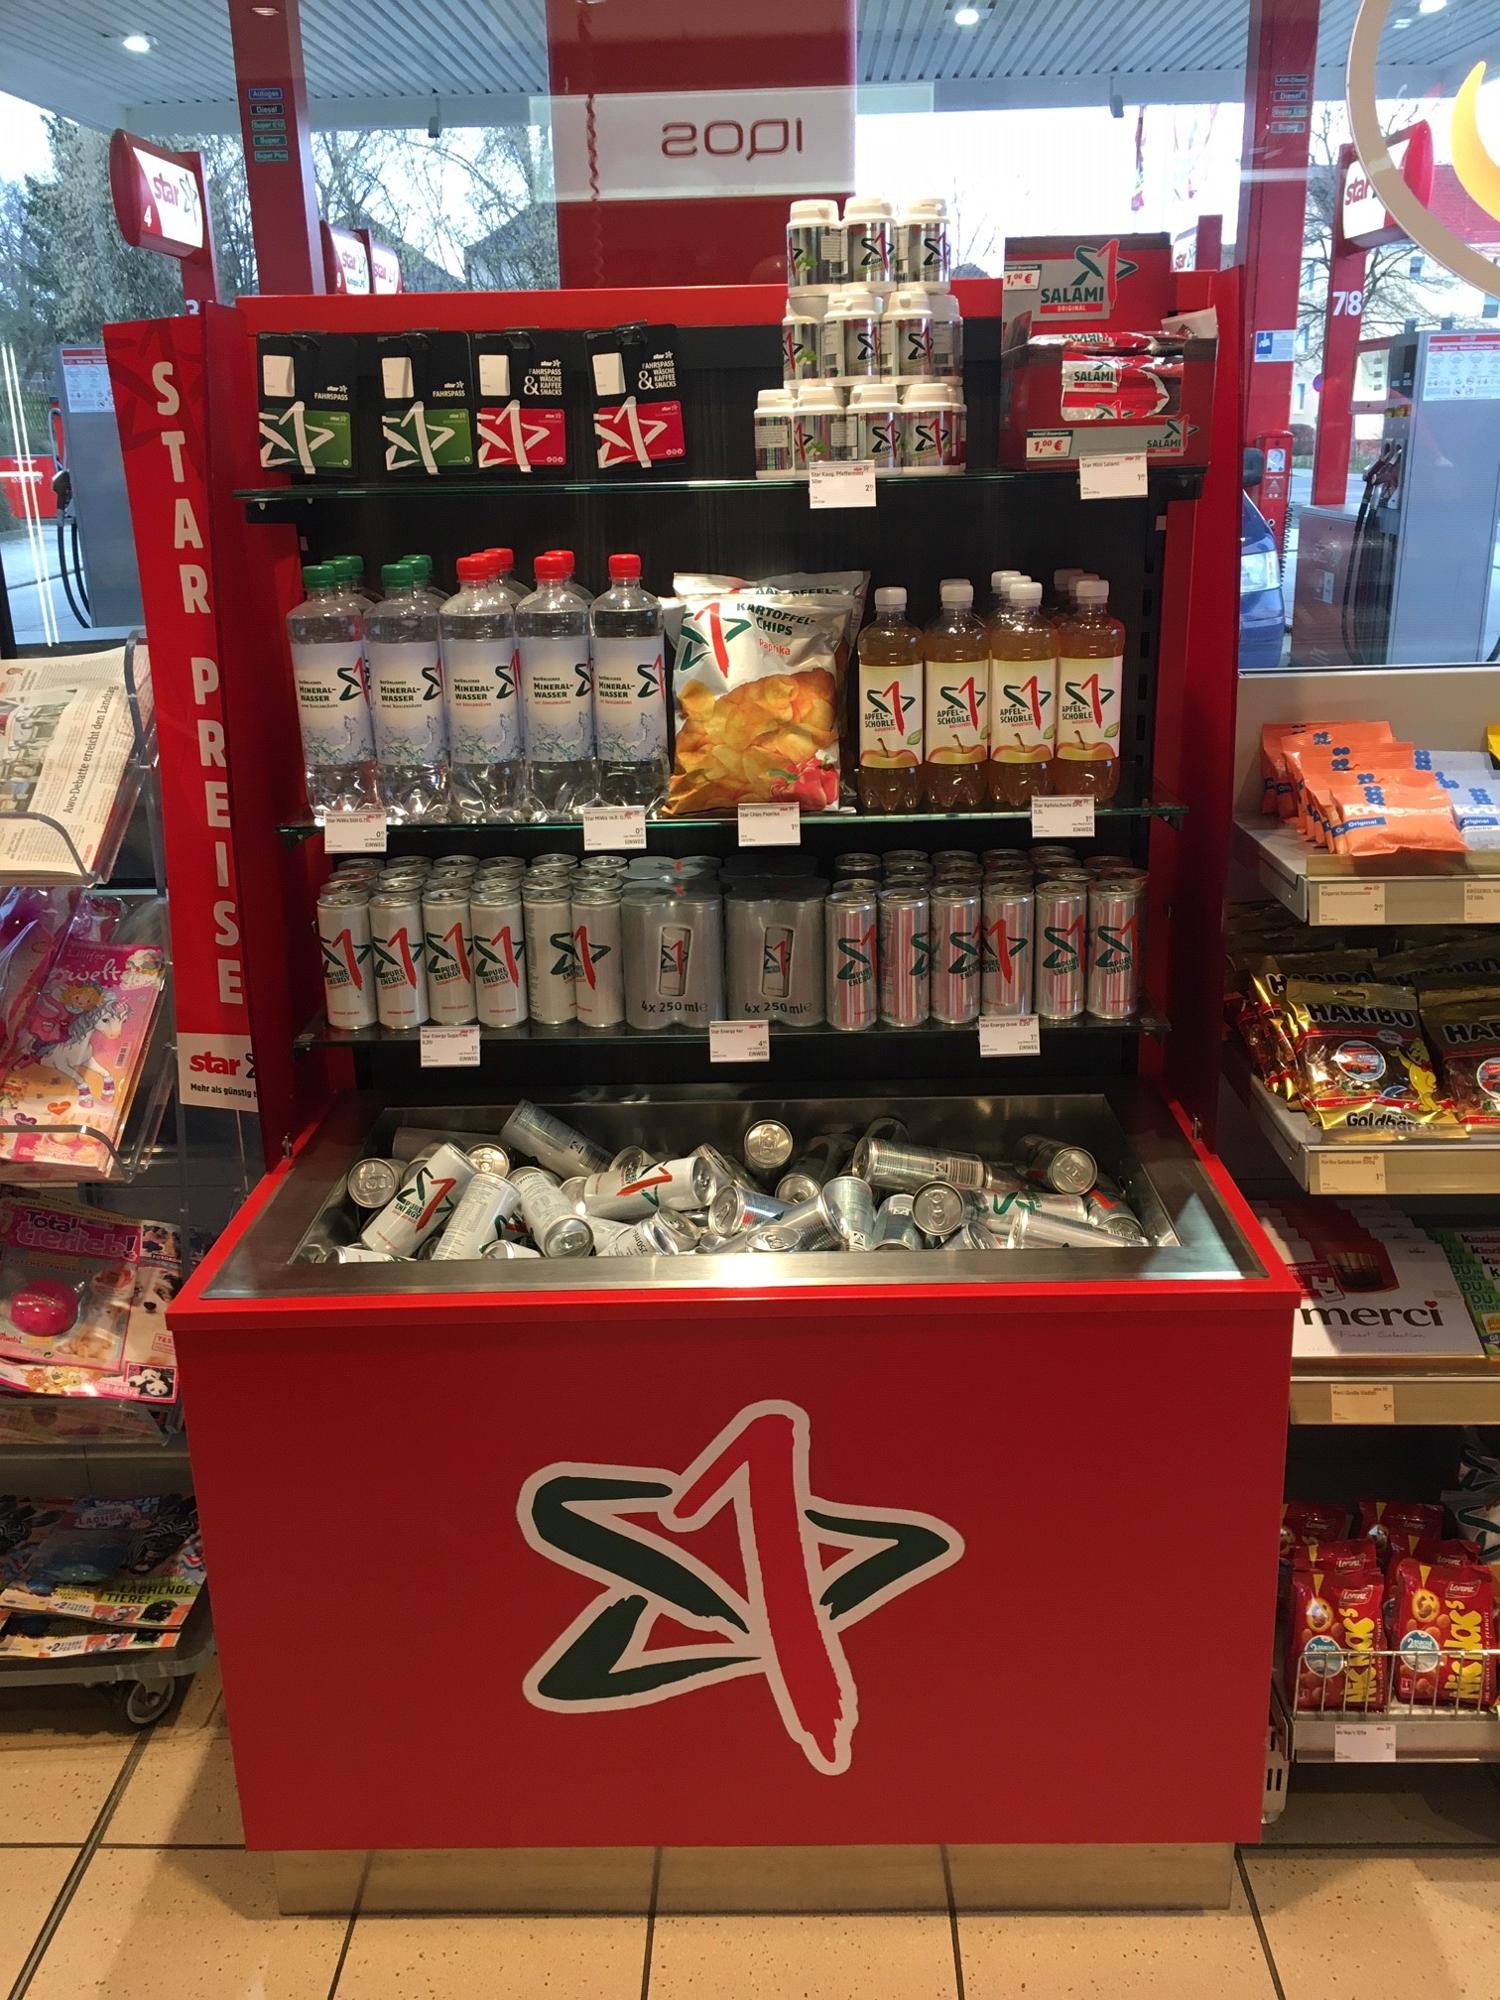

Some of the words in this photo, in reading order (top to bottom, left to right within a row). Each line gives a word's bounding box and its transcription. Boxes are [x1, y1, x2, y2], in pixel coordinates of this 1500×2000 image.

[153, 171, 179, 207] star
[144, 204, 152, 228] 4
[1040, 286, 1105, 304] SALAMI
[1057, 304, 1086, 312] ORIGINAL
[642, 360, 675, 370] FAHRSPASS
[528, 368, 562, 376] FAHRSPASS
[1073, 371, 1114, 382] SALAMI
[637, 370, 656, 390] &
[654, 374, 676, 382] KAFFEE
[523, 375, 539, 396] &
[539, 381, 563, 389] KAFFEE
[314, 392, 348, 401] FAHRSPASS
[432, 389, 466, 398] FAHRSPASS
[1054, 440, 1064, 452] €
[1146, 439, 1182, 449] SALAMI
[151, 360, 212, 615] STAR
[736, 602, 817, 625] KARTOFFEL-
[755, 617, 793, 636] CHIPS
[759, 638, 791, 656] Paprika
[380, 686, 421, 694] MINERAL-
[454, 684, 495, 692] MINERAL-
[533, 683, 574, 691] MINERAL-
[97, 685, 120, 714] Landtag
[381, 694, 415, 702] WASSER
[937, 709, 964, 718] APFEL-
[1000, 708, 1027, 717] APFEL-
[1062, 705, 1087, 713] APFEL-
[864, 712, 889, 721] APFEL-
[937, 715, 971, 725] SCHORLE
[1000, 714, 1034, 723] SCHORLE
[1062, 711, 1093, 720] SCHORLE
[91, 713, 106, 731] den
[864, 719, 896, 728] SCHORLE
[83, 730, 101, 763] erreicht
[62, 762, 89, 814] Awo-Debatte
[1349, 818, 1376, 828] Original
[189, 656, 244, 1005] PREISE
[330, 970, 348, 978] PURE
[384, 968, 404, 977] PURE
[439, 965, 460, 974] PURE
[487, 967, 507, 978] PURE
[327, 975, 351, 985] ENERGY
[380, 974, 406, 985] ENERGY
[435, 970, 461, 982] ENERGY
[482, 974, 509, 985] ENERGY
[641, 1000, 656, 1013] 4x
[659, 1000, 683, 1013] 250
[744, 1001, 760, 1014] 4x
[763, 1001, 788, 1013] 250
[1306, 1000, 1417, 1029] HARIBO
[189, 1050, 241, 1076] star
[190, 1083, 210, 1092] Mehr
[211, 1085, 223, 1094] als
[223, 1087, 252, 1098] günstig
[404, 1200, 425, 1213] PURE
[1300, 1300, 1444, 1327] merci
[1338, 1558, 1362, 1568] Lorenz
[1449, 1583, 1476, 1594] Lorenz
[105, 1592, 152, 1605] TIERE!
[1343, 1590, 1369, 1600] Lorenz
